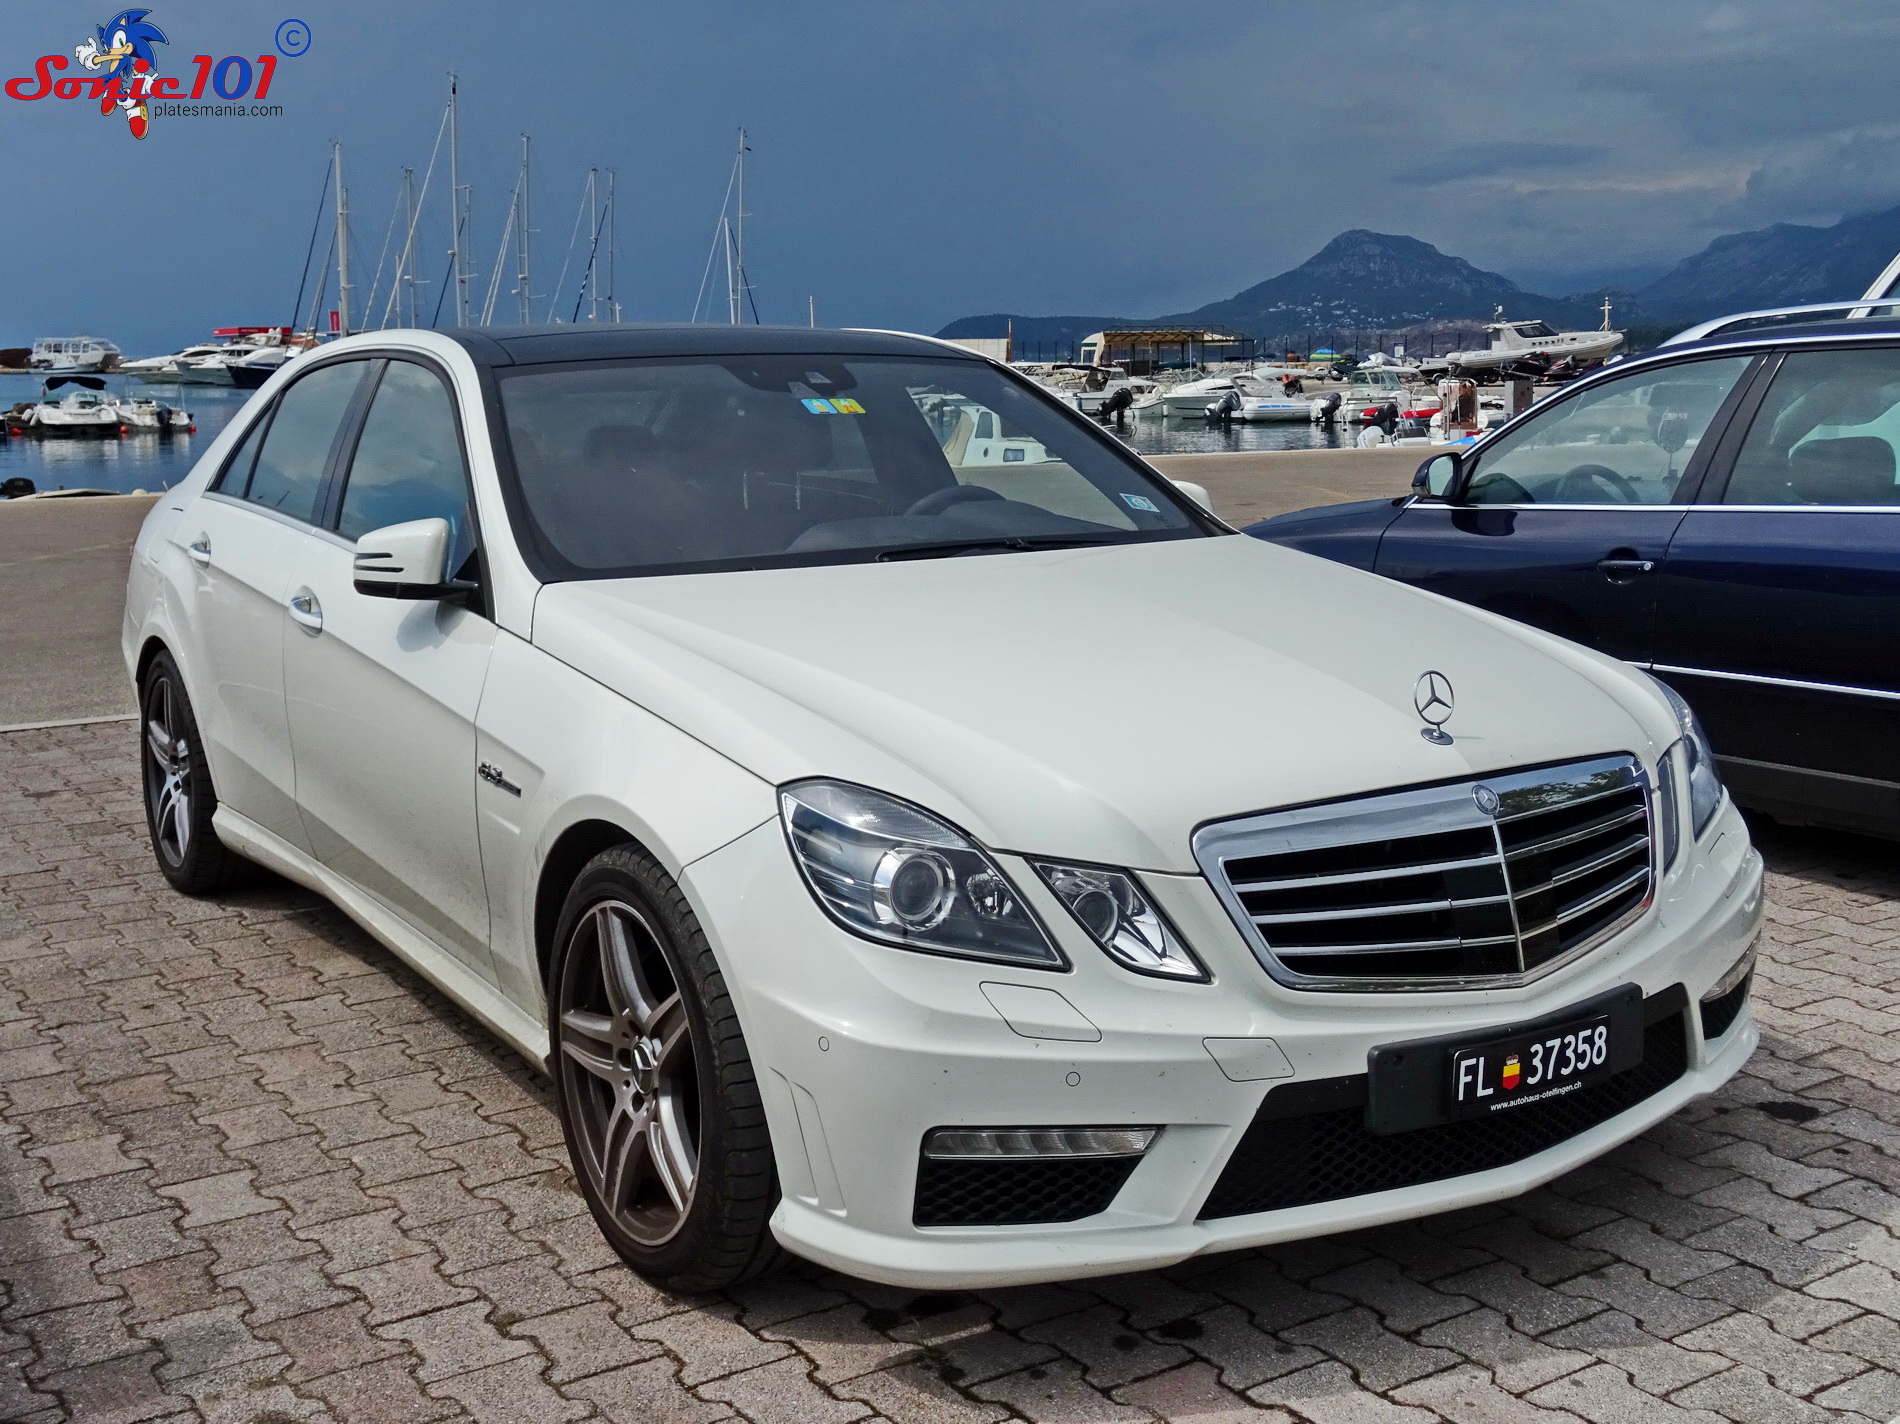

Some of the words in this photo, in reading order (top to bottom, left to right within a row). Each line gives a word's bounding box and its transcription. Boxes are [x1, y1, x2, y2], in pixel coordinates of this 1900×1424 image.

[1458, 1057, 1494, 1101] FL
[1526, 1025, 1608, 1085] 37358
[1490, 1081, 1582, 1111] www.autohaus-otelfingen.ch
